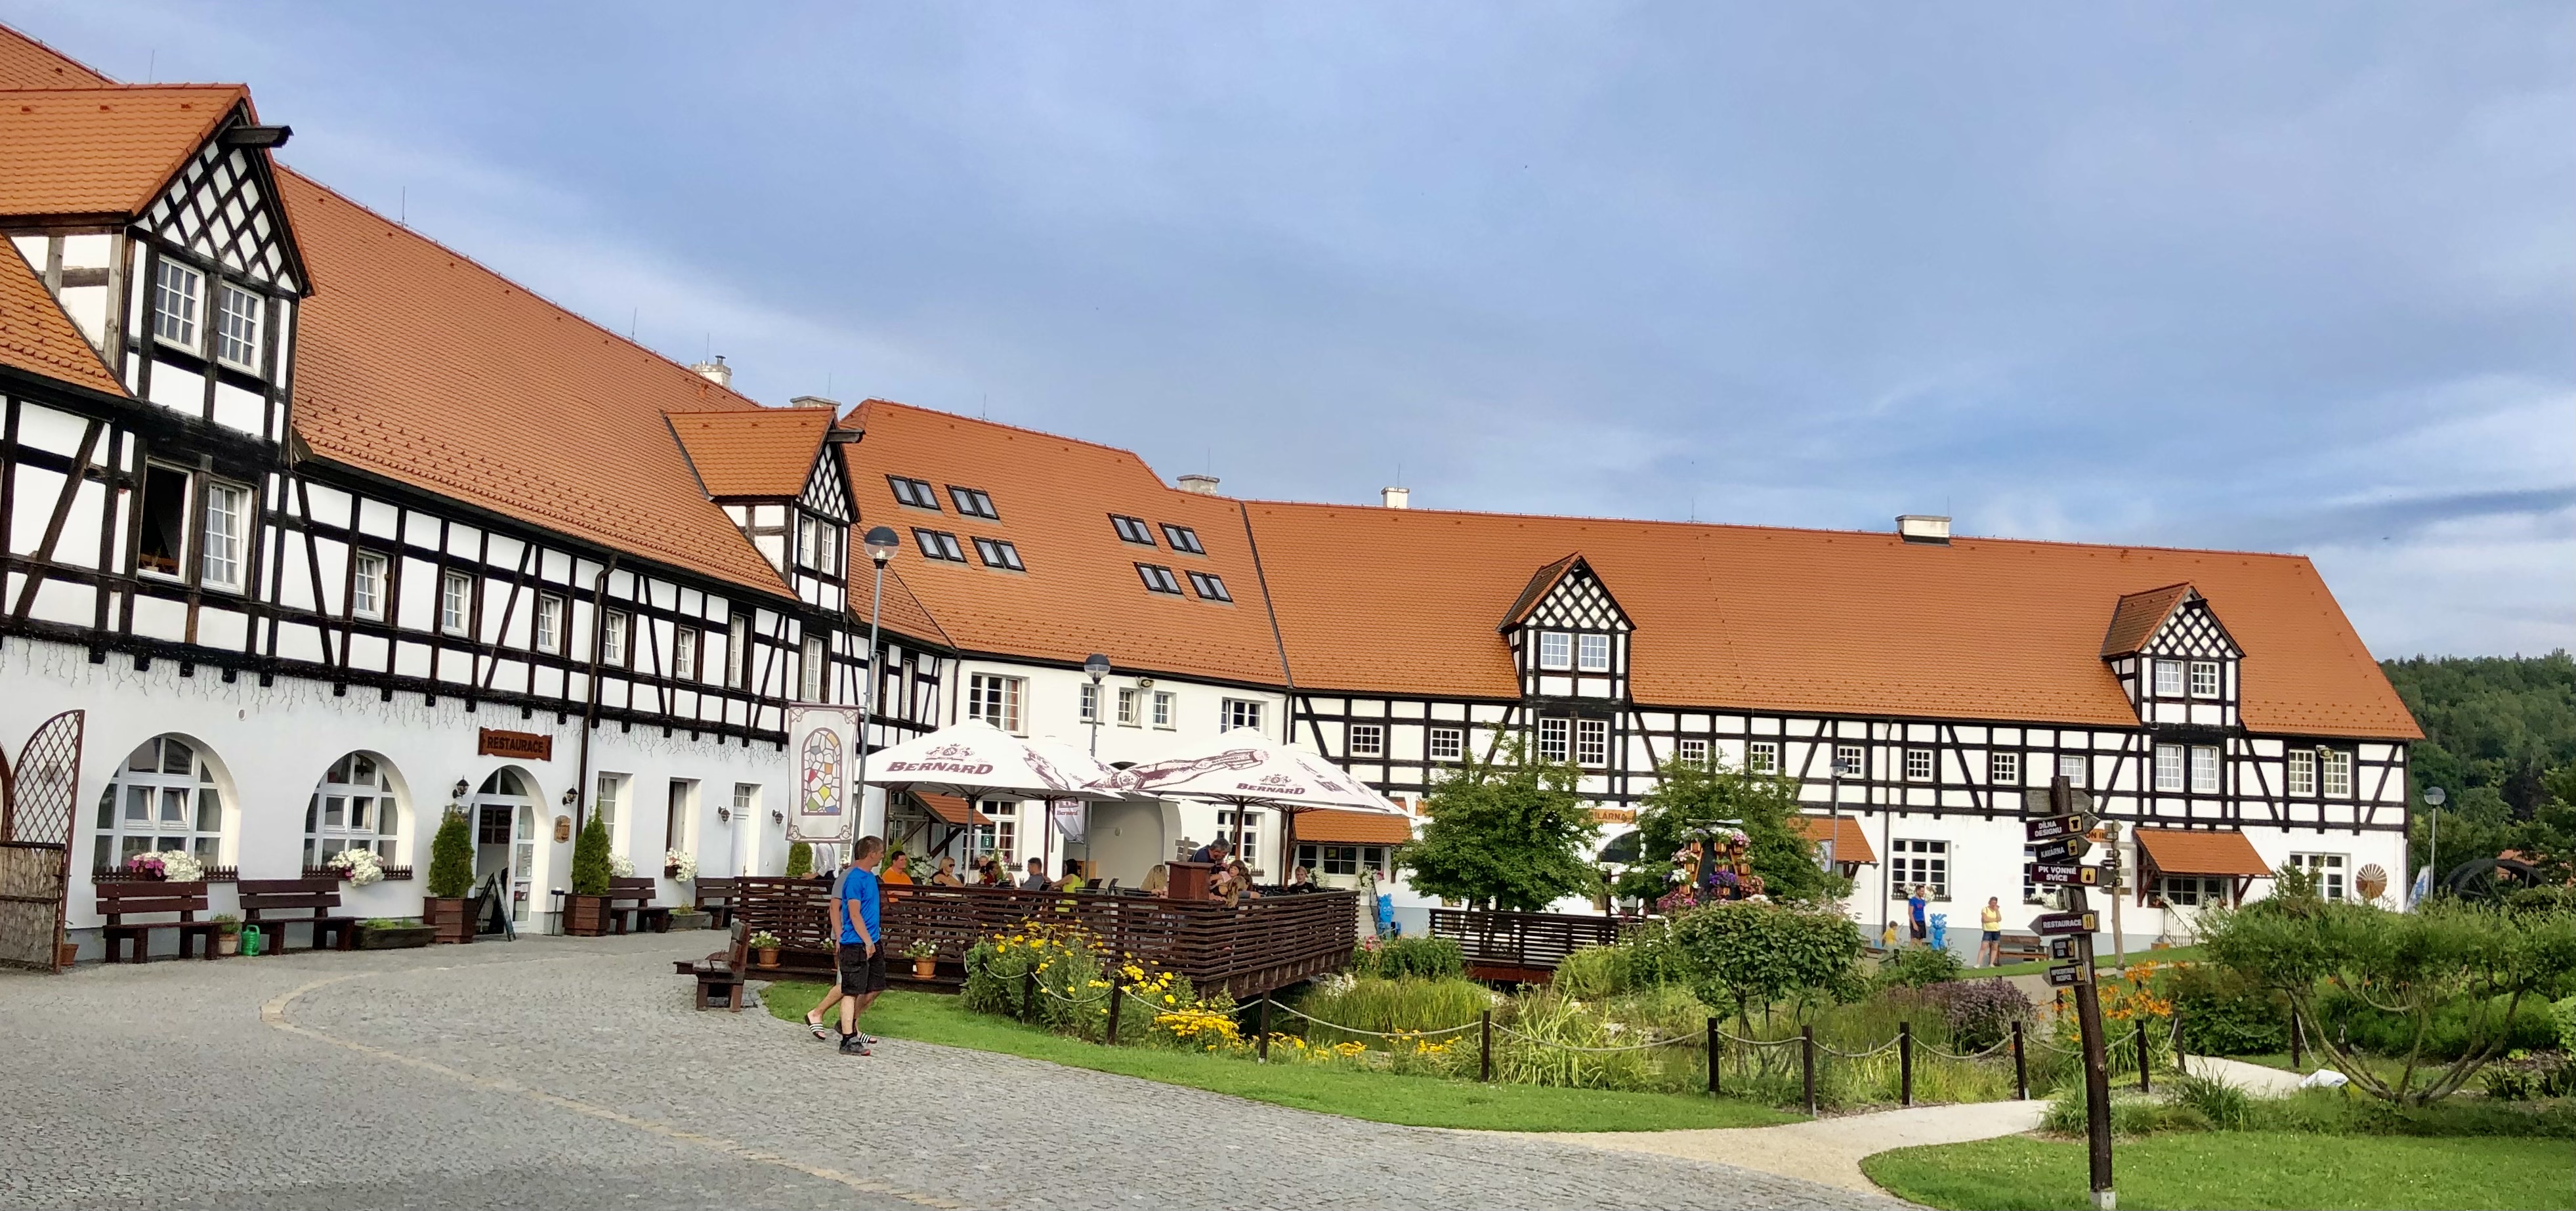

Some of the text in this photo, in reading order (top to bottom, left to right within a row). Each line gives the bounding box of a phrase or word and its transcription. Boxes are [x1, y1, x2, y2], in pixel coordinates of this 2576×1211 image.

[487, 736, 543, 754] RESTAURACE
[886, 761, 994, 775] BERNARD
[1236, 782, 1305, 795] BERNARD
[2038, 820, 2057, 830] DÍLNA
[2035, 826, 2062, 837] DESIGNU
[2040, 846, 2065, 859] KAVÁRNA
[2046, 872, 2068, 882] SVÍCE
[2042, 919, 2082, 929] RESTAURACE
